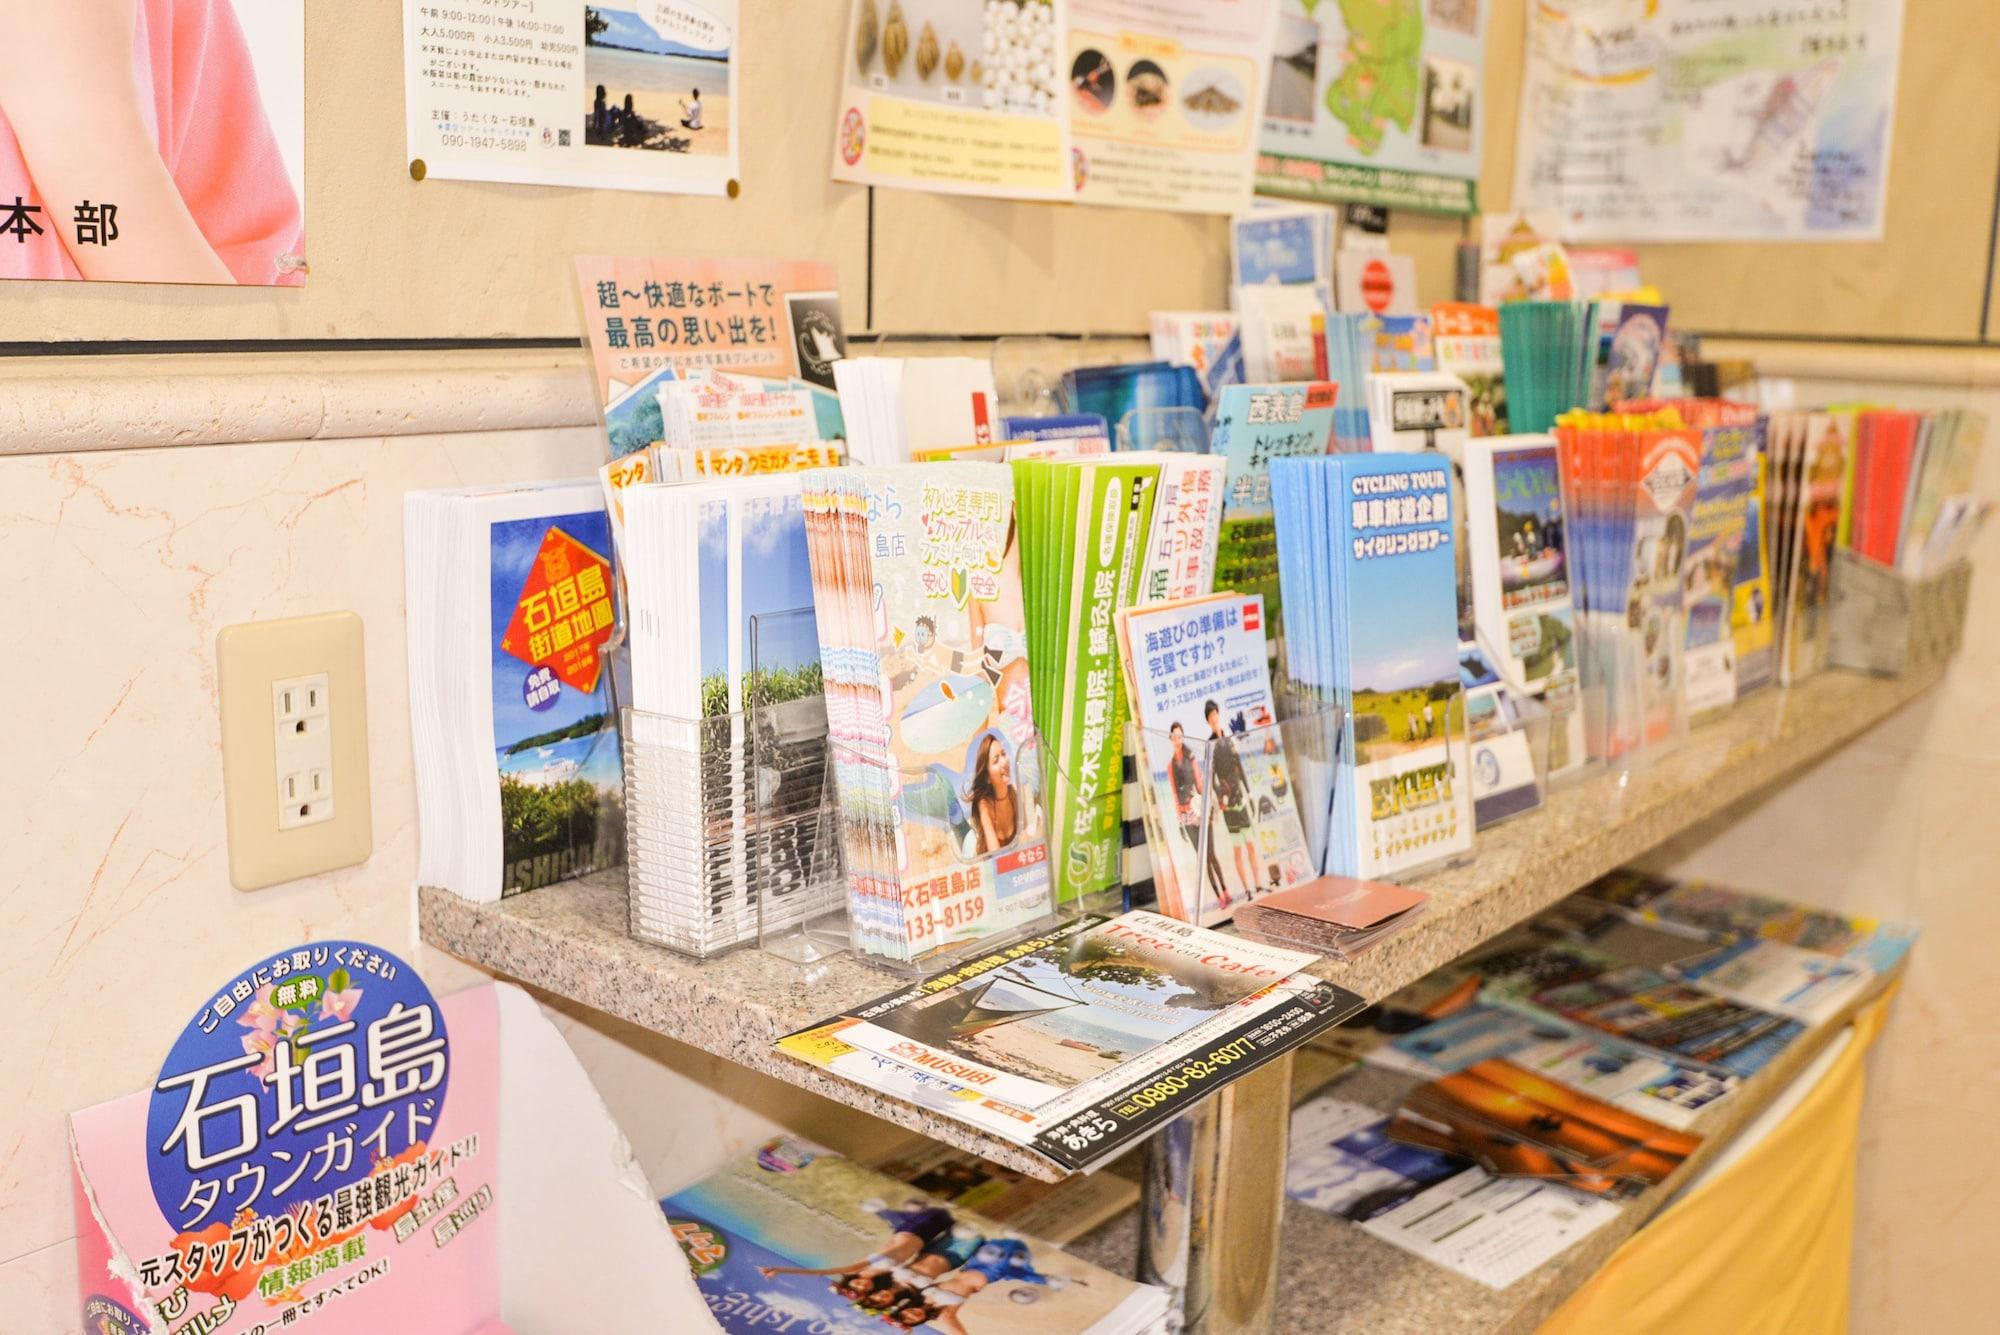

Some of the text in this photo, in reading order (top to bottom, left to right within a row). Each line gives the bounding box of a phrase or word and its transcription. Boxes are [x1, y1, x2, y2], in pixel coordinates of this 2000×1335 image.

[420, 6, 439, 19] 午前
[442, 134, 527, 152] 090-1947-5898
[1352, 469, 1447, 496] CYCLING TOUR
[923, 487, 1001, 523] 初心者専門
[875, 532, 905, 558] 島店
[520, 563, 607, 633] 石垣島
[922, 571, 998, 596] 安心 安全
[1145, 607, 1239, 654] 海遊びの準備は
[1104, 923, 1175, 951] Tree
[1200, 954, 1278, 979] Cafe
[197, 946, 398, 1036] ご自由にお取りください
[276, 976, 320, 1007] 無料
[156, 1001, 448, 1172] 石垣島
[912, 1050, 999, 1087] MUSUBI
[1117, 1104, 1140, 1117] TEL
[1131, 1035, 1257, 1109] 0980-82-6077
[1061, 1116, 1119, 1151] あきら
[178, 1098, 436, 1231] タウンガイド
[257, 1234, 369, 1300] 情報満載
